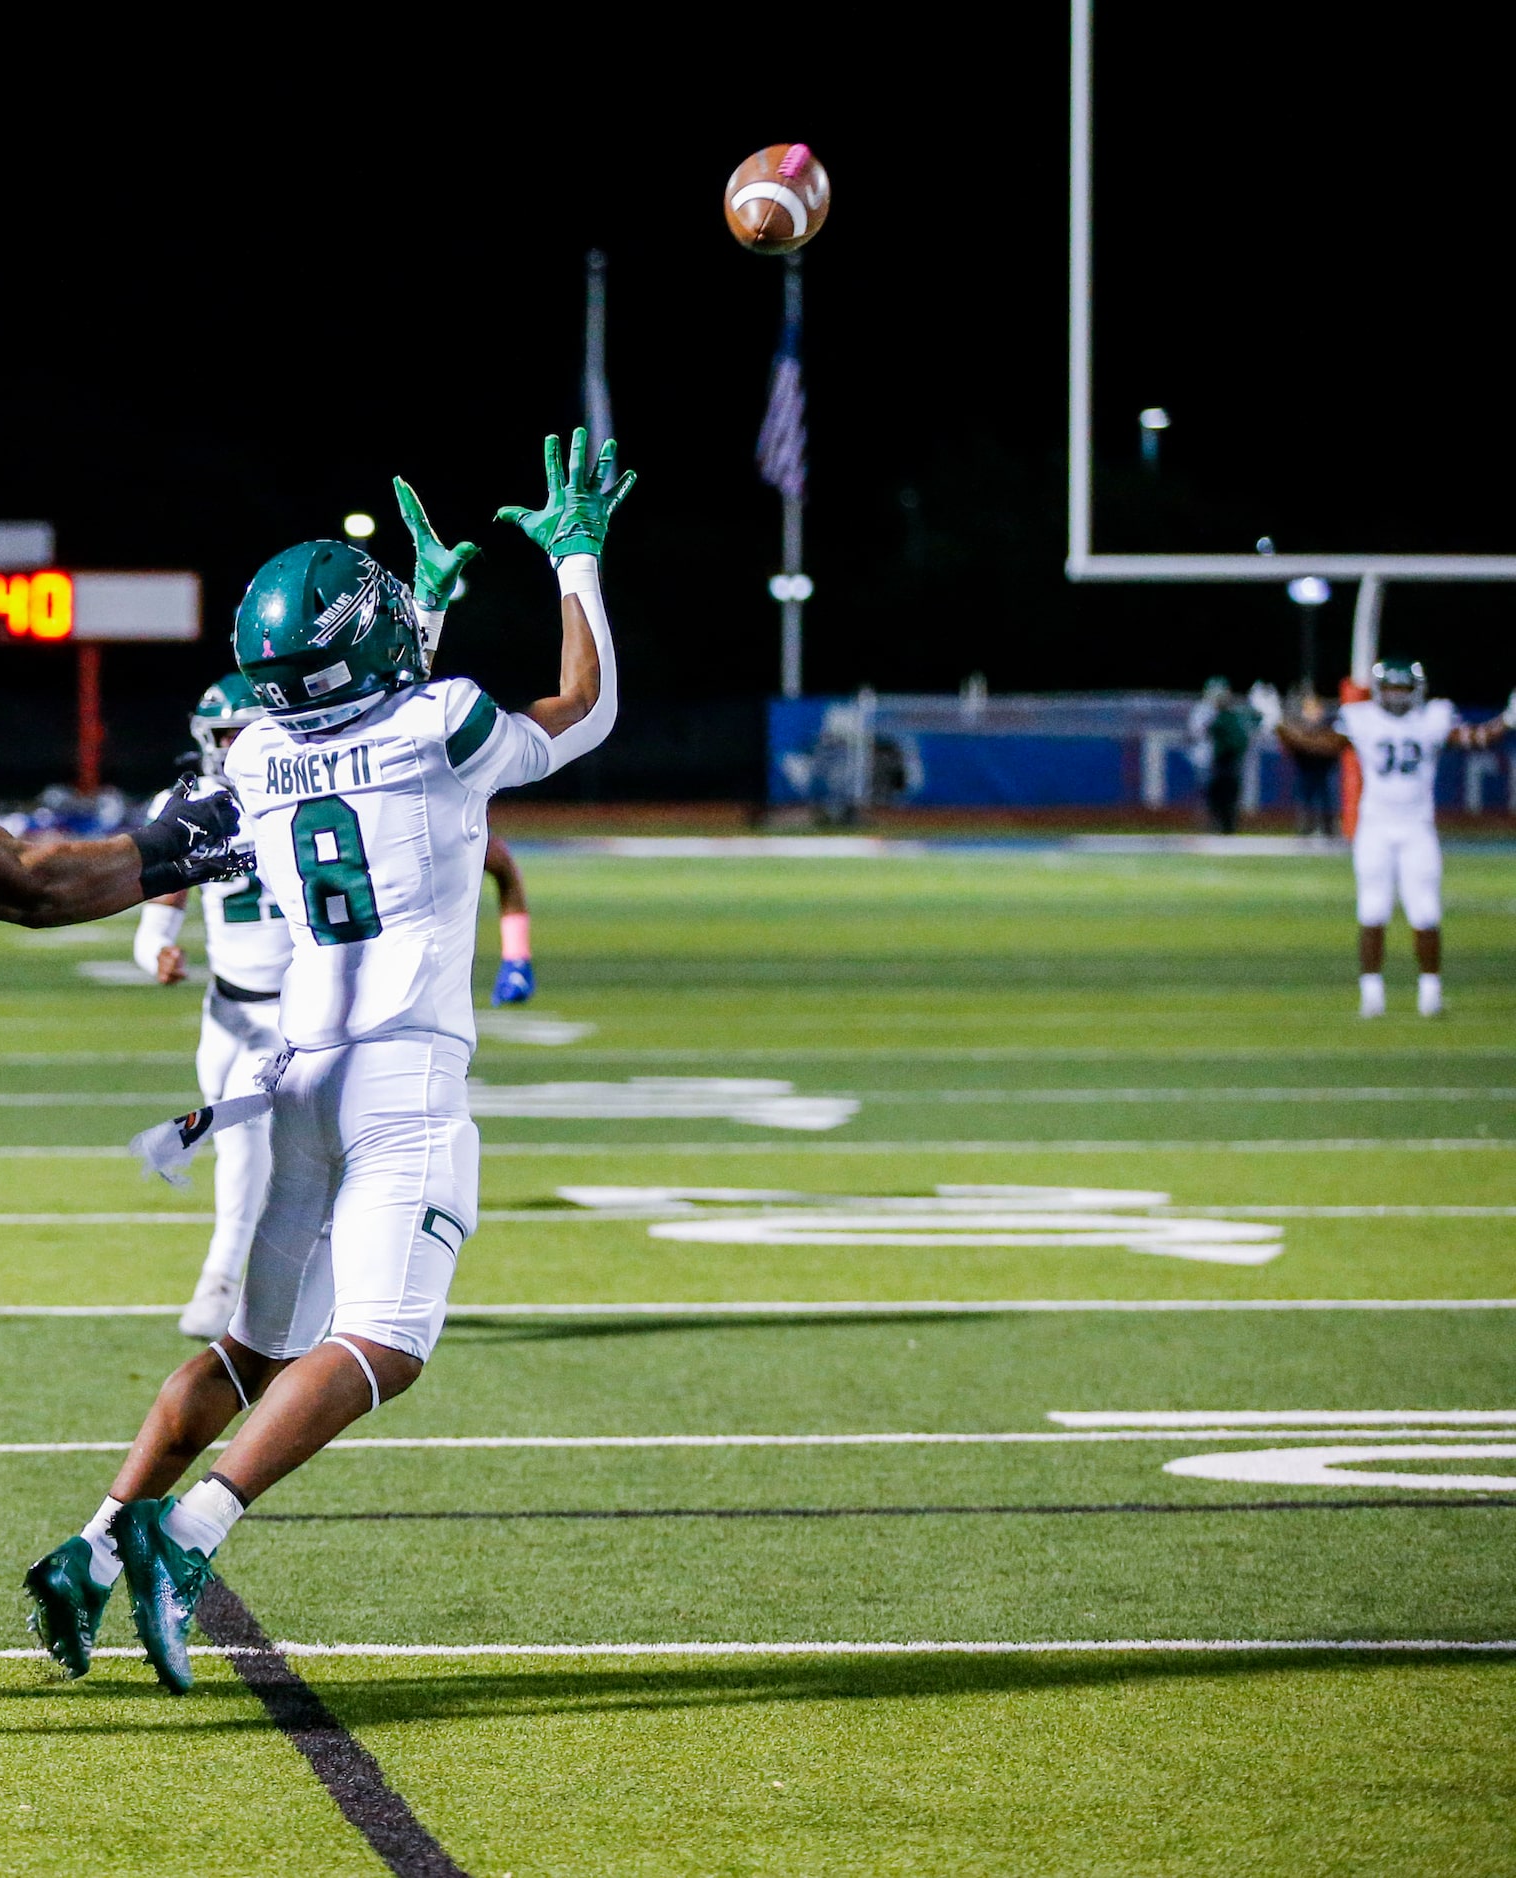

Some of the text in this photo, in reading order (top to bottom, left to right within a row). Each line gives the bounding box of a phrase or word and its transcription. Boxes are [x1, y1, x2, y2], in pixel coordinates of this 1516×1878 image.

[313, 592, 353, 628] INDIANS
[266, 751, 339, 794] ABNEY
[290, 794, 383, 946] 8
